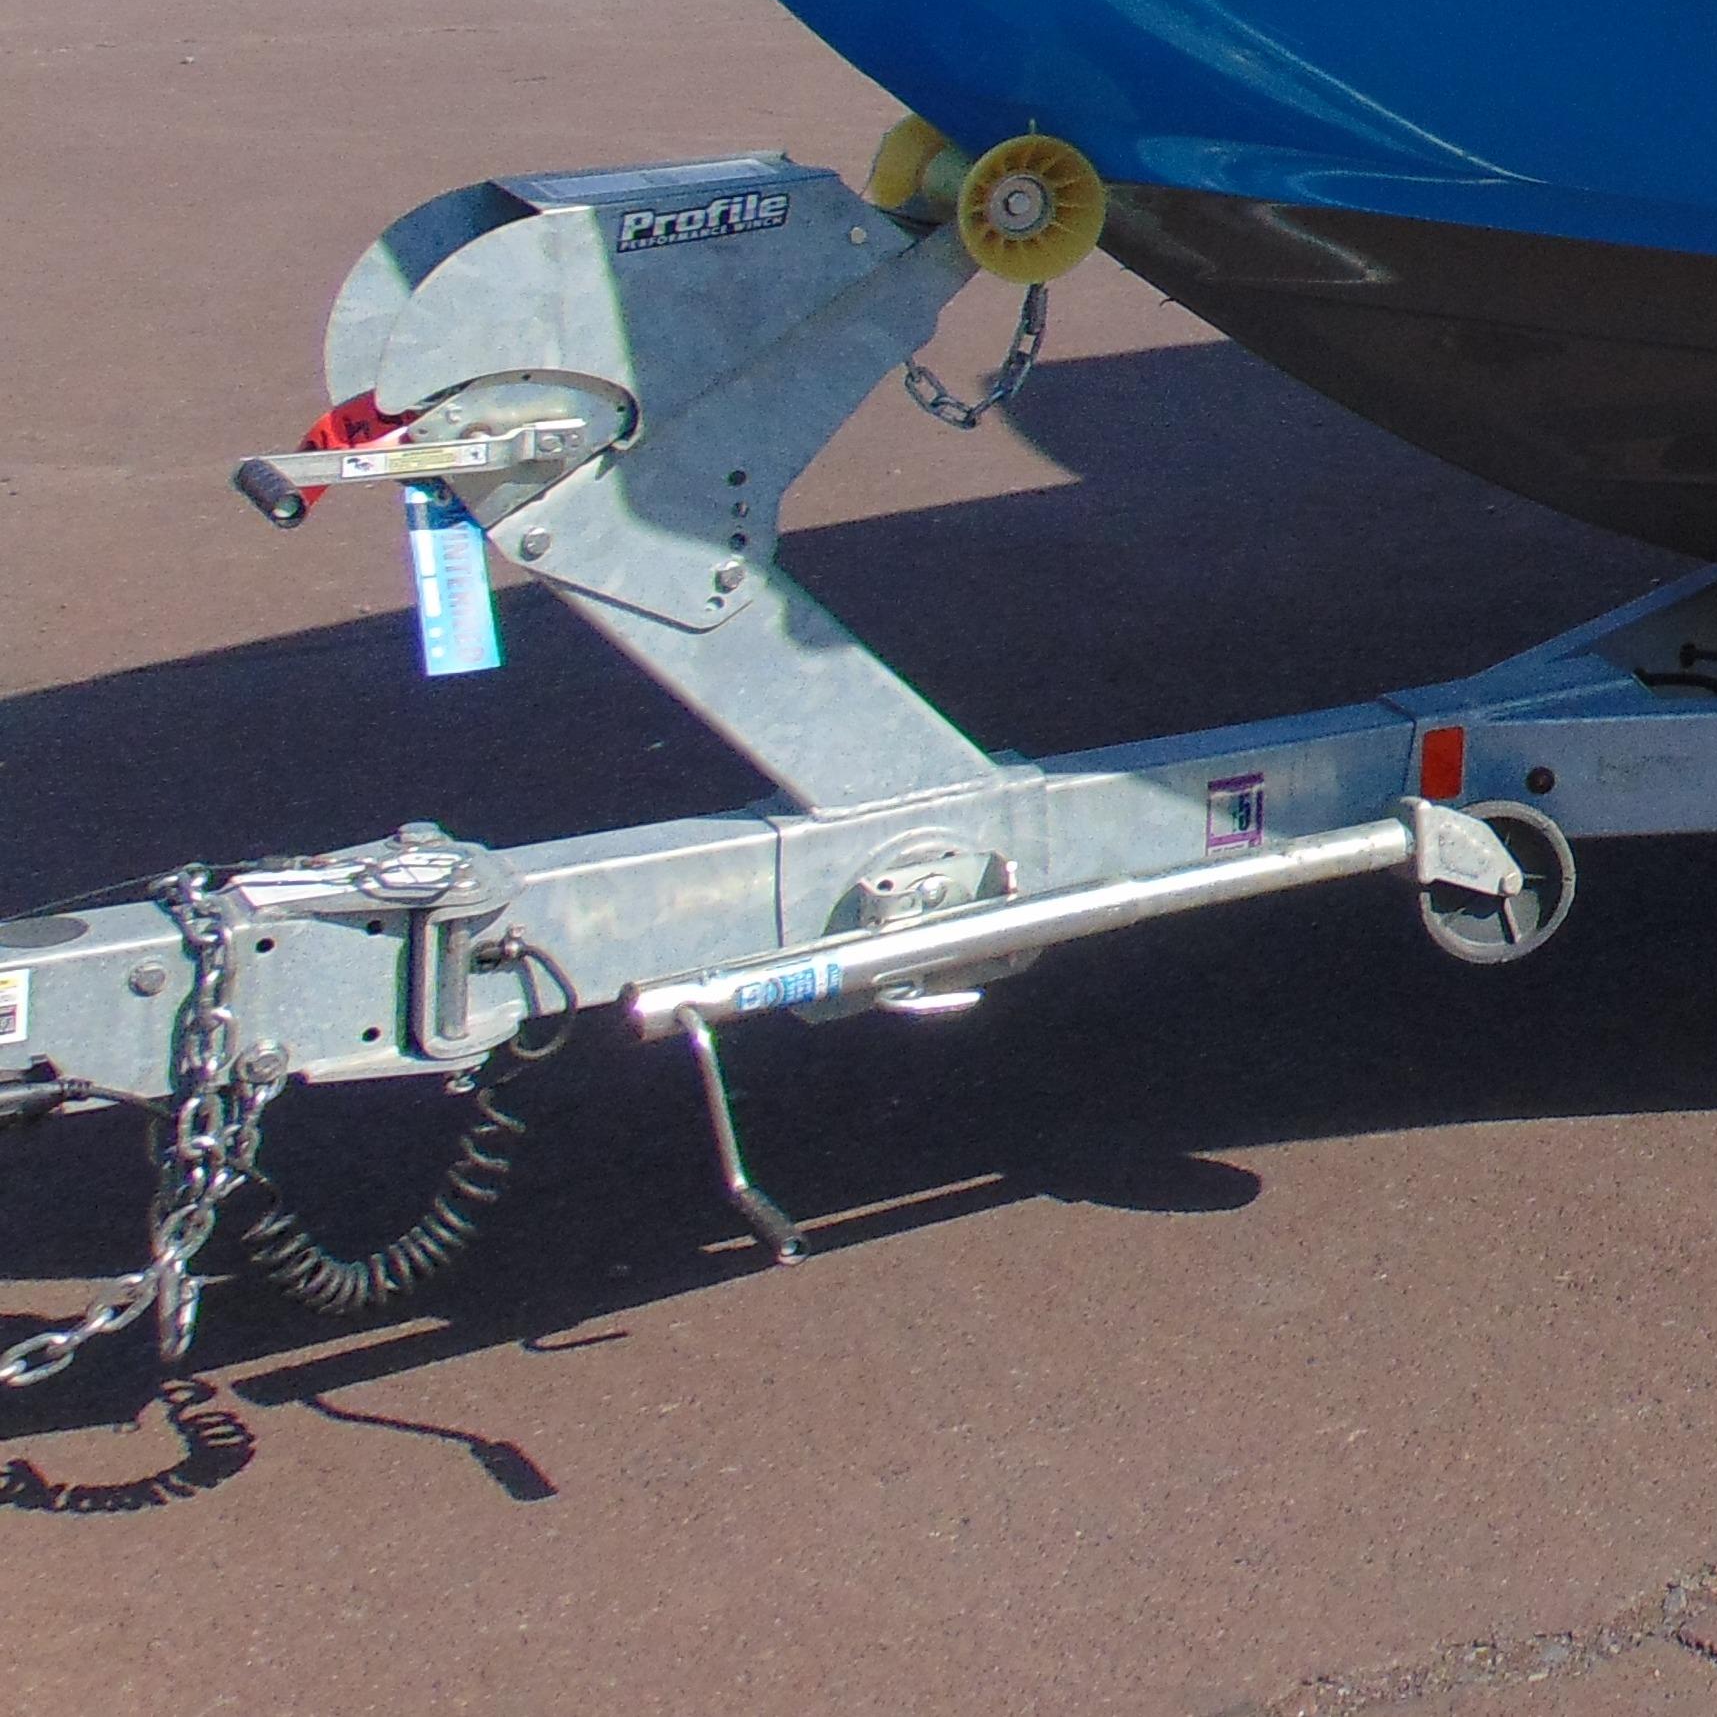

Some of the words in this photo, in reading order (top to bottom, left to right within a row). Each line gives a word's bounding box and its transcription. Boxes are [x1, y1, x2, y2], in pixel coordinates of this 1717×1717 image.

[618, 225, 728, 252] PERFORMANCE
[734, 216, 784, 233] WINCH
[621, 193, 790, 241] Profile
